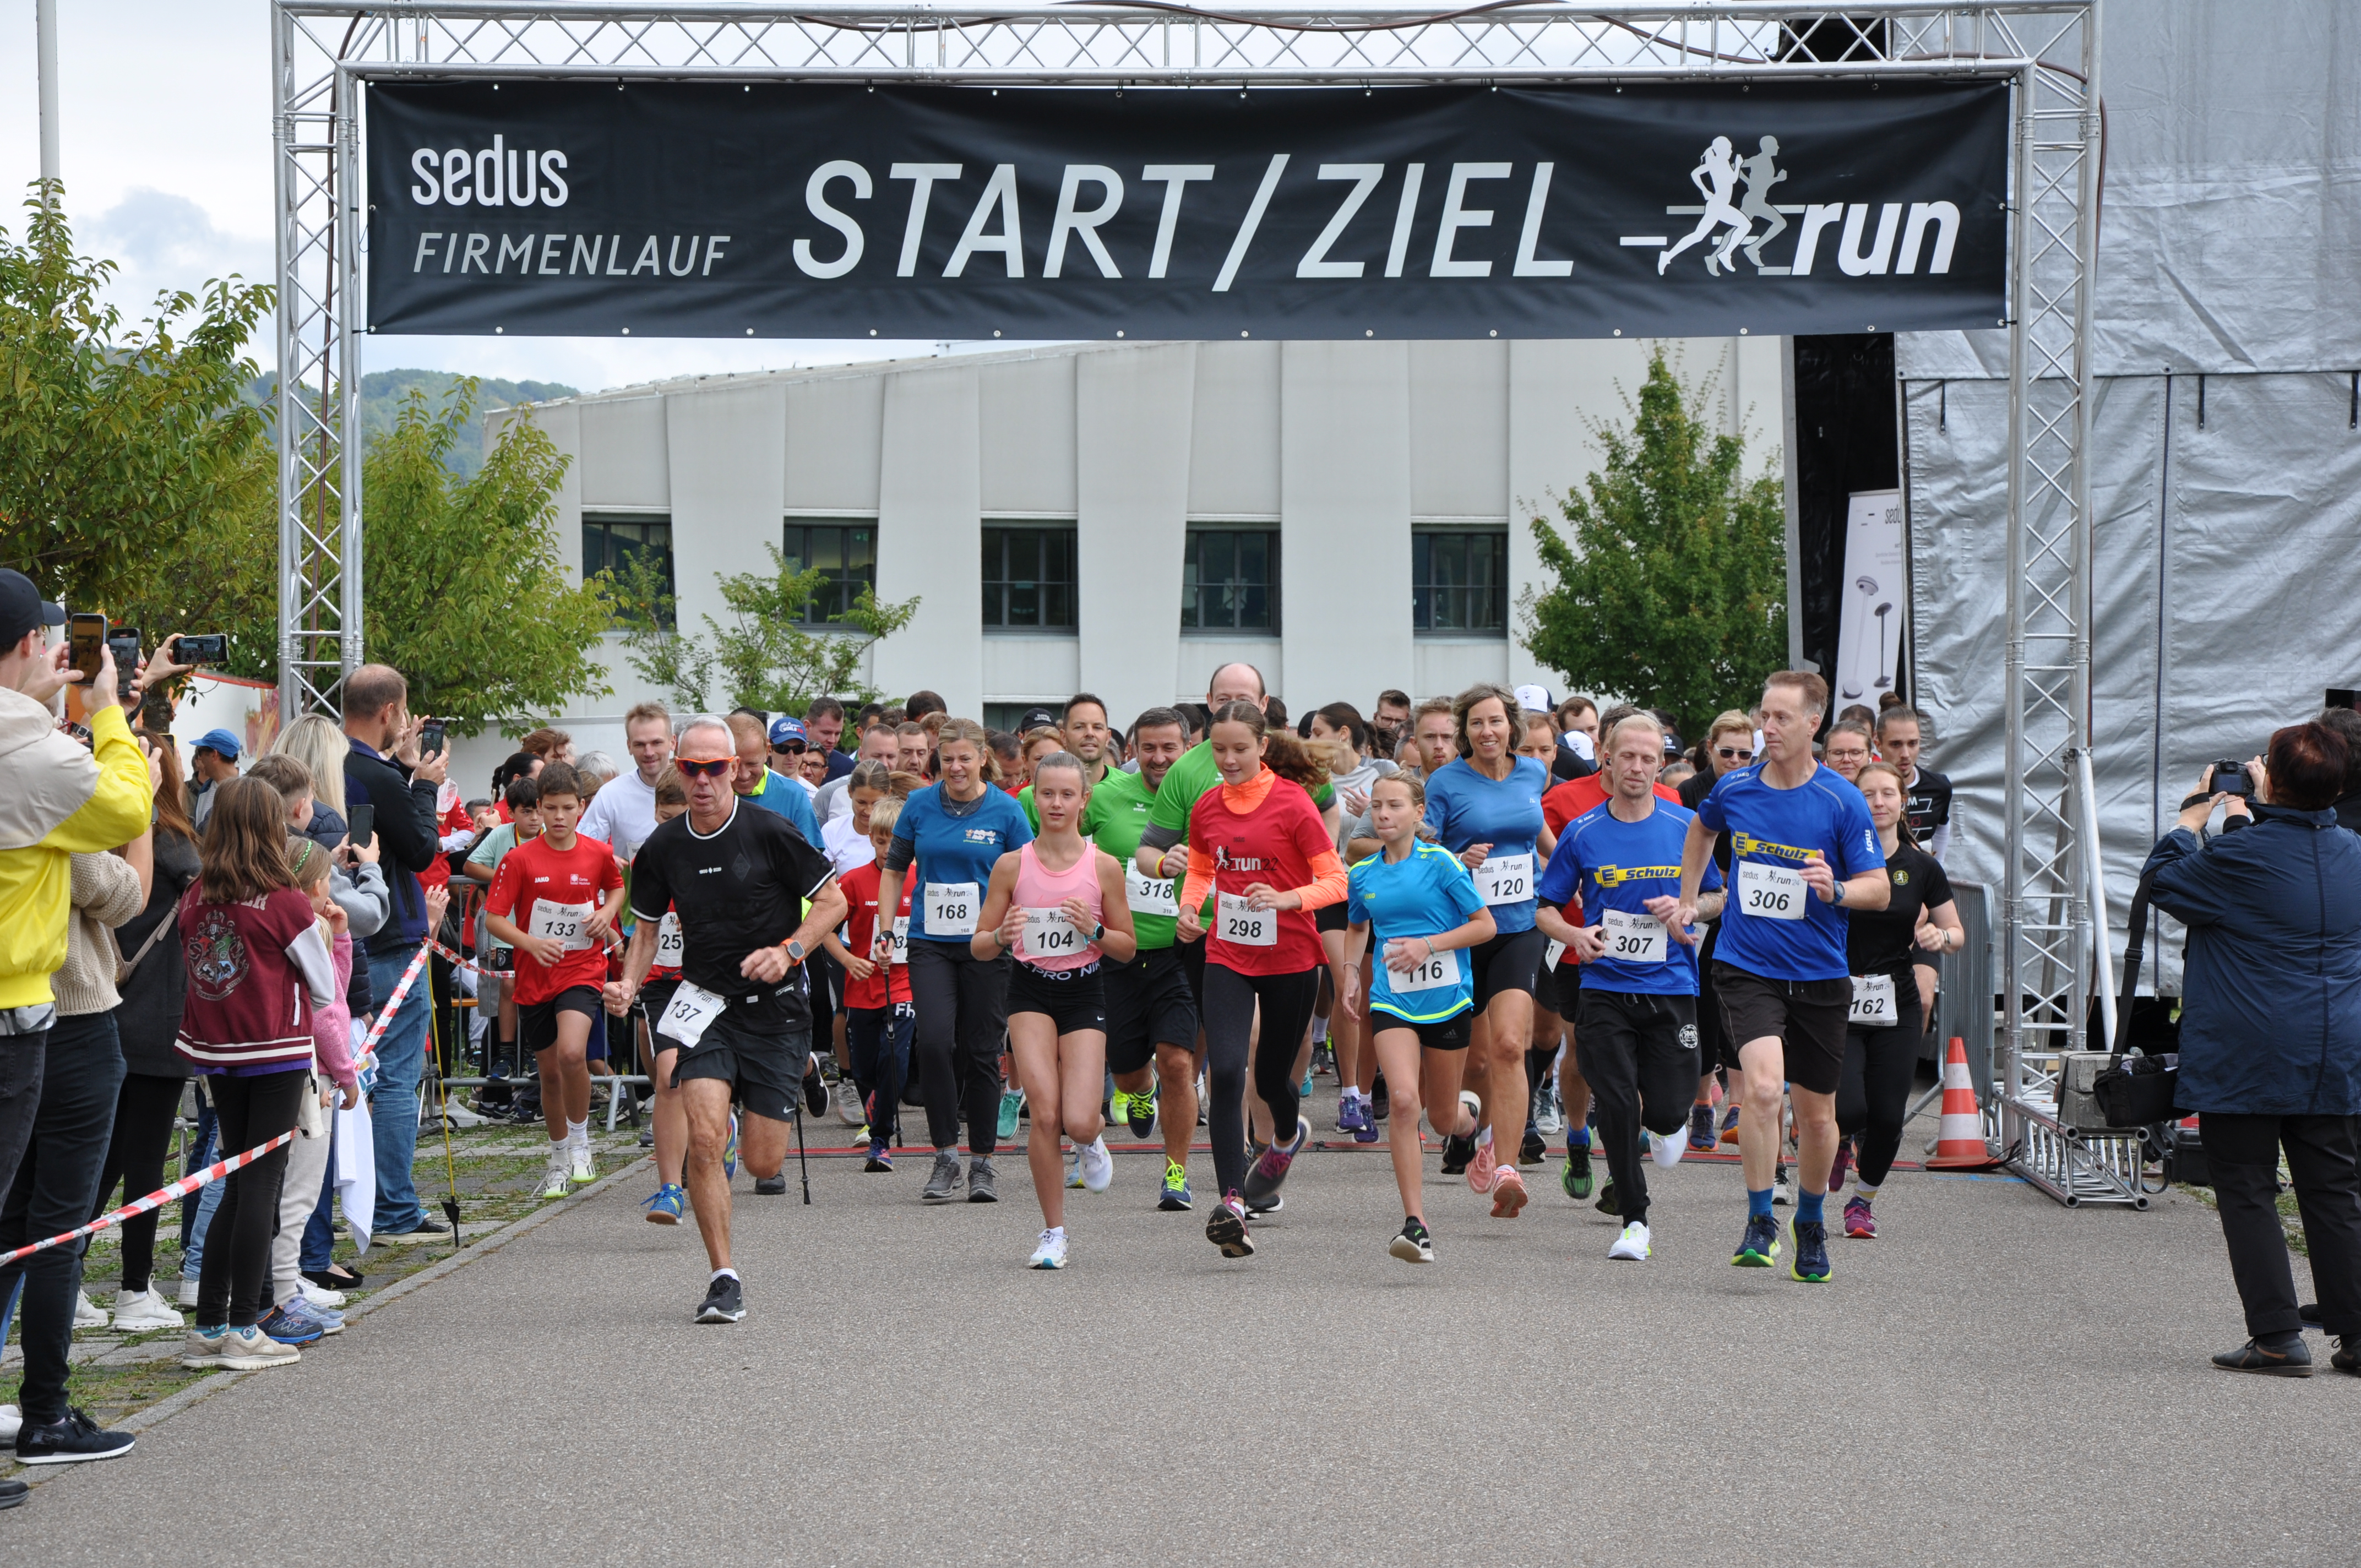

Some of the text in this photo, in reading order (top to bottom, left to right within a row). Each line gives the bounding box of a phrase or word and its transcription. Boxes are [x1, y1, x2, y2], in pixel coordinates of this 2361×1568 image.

[411, 134, 569, 207] sedus
[793, 160, 1215, 279] START
[1296, 162, 1574, 278] ZIEL
[1791, 199, 1961, 276] run
[413, 232, 731, 277] FIRMENLAUF
[1755, 842, 1810, 860] Schulz
[1478, 866, 1494, 874] sedus
[1625, 867, 1677, 880] Schulz
[1742, 870, 1759, 880] sedus
[927, 889, 940, 897] sedus
[1139, 880, 1173, 899] 318
[1492, 878, 1524, 897] 120
[1221, 899, 1233, 910] sedus
[1749, 889, 1790, 911] 306
[537, 905, 553, 914] sedus
[937, 903, 967, 919] 168
[545, 921, 576, 937] 133
[1228, 918, 1262, 938] 298
[1607, 917, 1624, 927] sedus
[1037, 930, 1074, 949] 104
[1615, 935, 1653, 955] 307
[1031, 965, 1072, 981] PRO
[1406, 960, 1443, 984] 116
[669, 999, 703, 1023] 137
[1851, 998, 1884, 1015] 162
